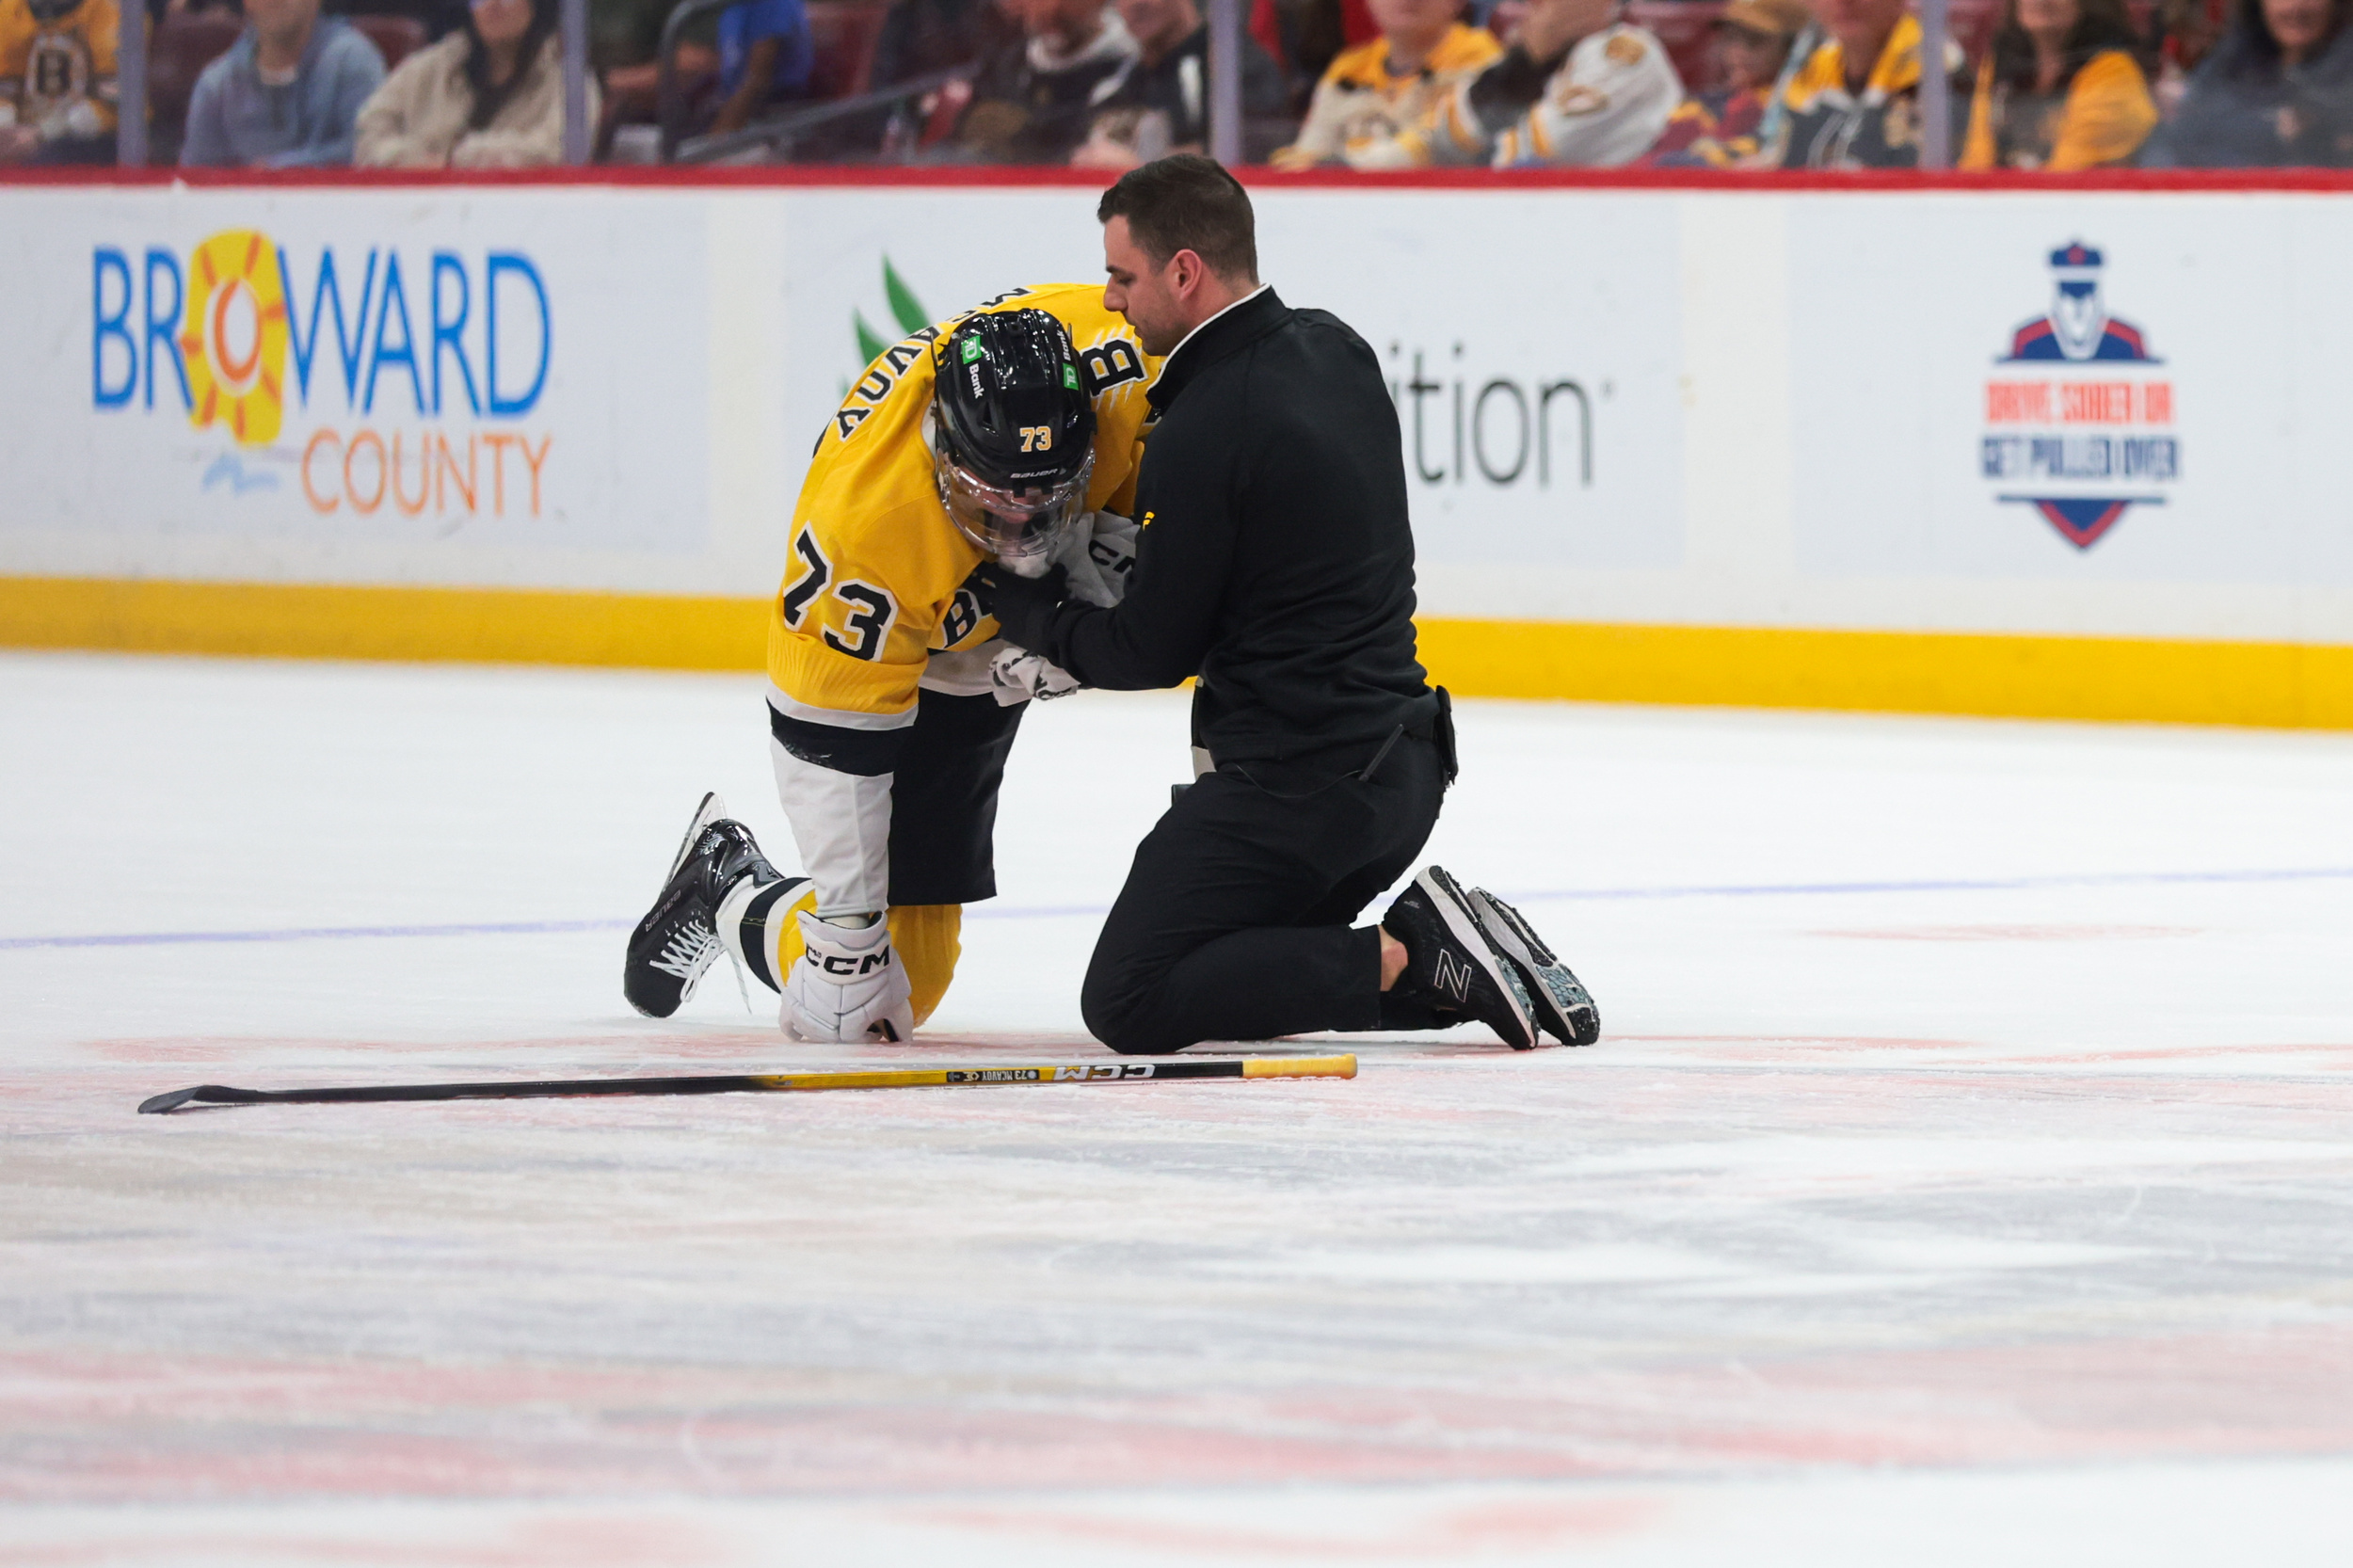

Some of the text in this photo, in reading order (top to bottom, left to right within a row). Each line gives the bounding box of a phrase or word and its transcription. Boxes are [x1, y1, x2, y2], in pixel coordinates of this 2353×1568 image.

[92, 241, 553, 420] BROWARD
[1056, 328, 1071, 360] Bank
[968, 363, 985, 399] Bank
[1080, 336, 1148, 398] B
[1019, 425, 1052, 453] 73
[298, 428, 553, 518] COUNTY
[1010, 468, 1058, 479] BAUER
[782, 520, 898, 662] 73
[644, 888, 681, 933] BAUER
[805, 943, 890, 975] CCM
[981, 1069, 1027, 1081] 73 MCAVOY
[1053, 1064, 1156, 1081] CCM
